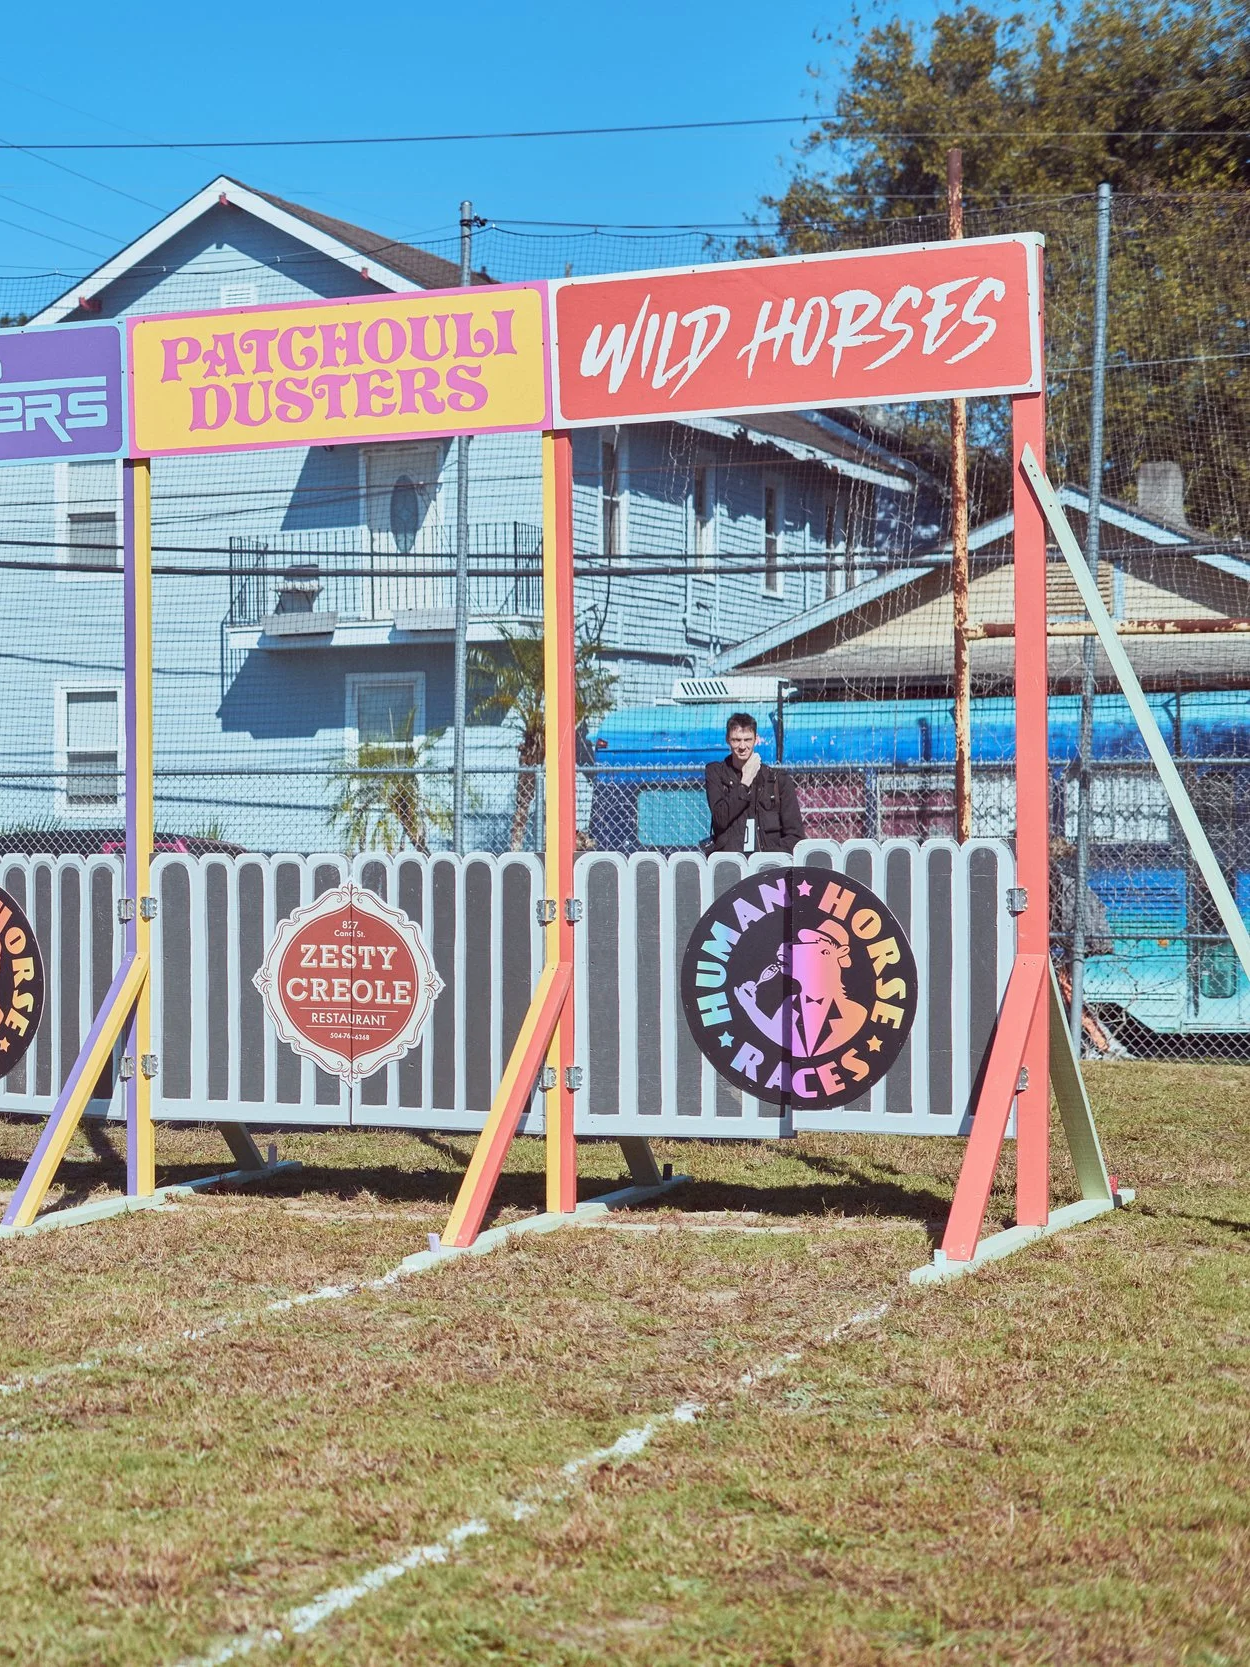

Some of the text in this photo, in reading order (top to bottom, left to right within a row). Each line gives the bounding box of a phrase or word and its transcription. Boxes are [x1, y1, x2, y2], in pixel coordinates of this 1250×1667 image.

[160, 309, 518, 383] PATCHOULI
[580, 276, 1006, 399] WILD HORSES
[188, 364, 489, 432] DUSTERS
[300, 944, 397, 970] ZESTY
[696, 878, 906, 1030] HUMAN HORSE
[286, 977, 412, 1005] CREOLE
[311, 1012, 387, 1026] RESTAURANT
[730, 1042, 870, 1099] RACES
